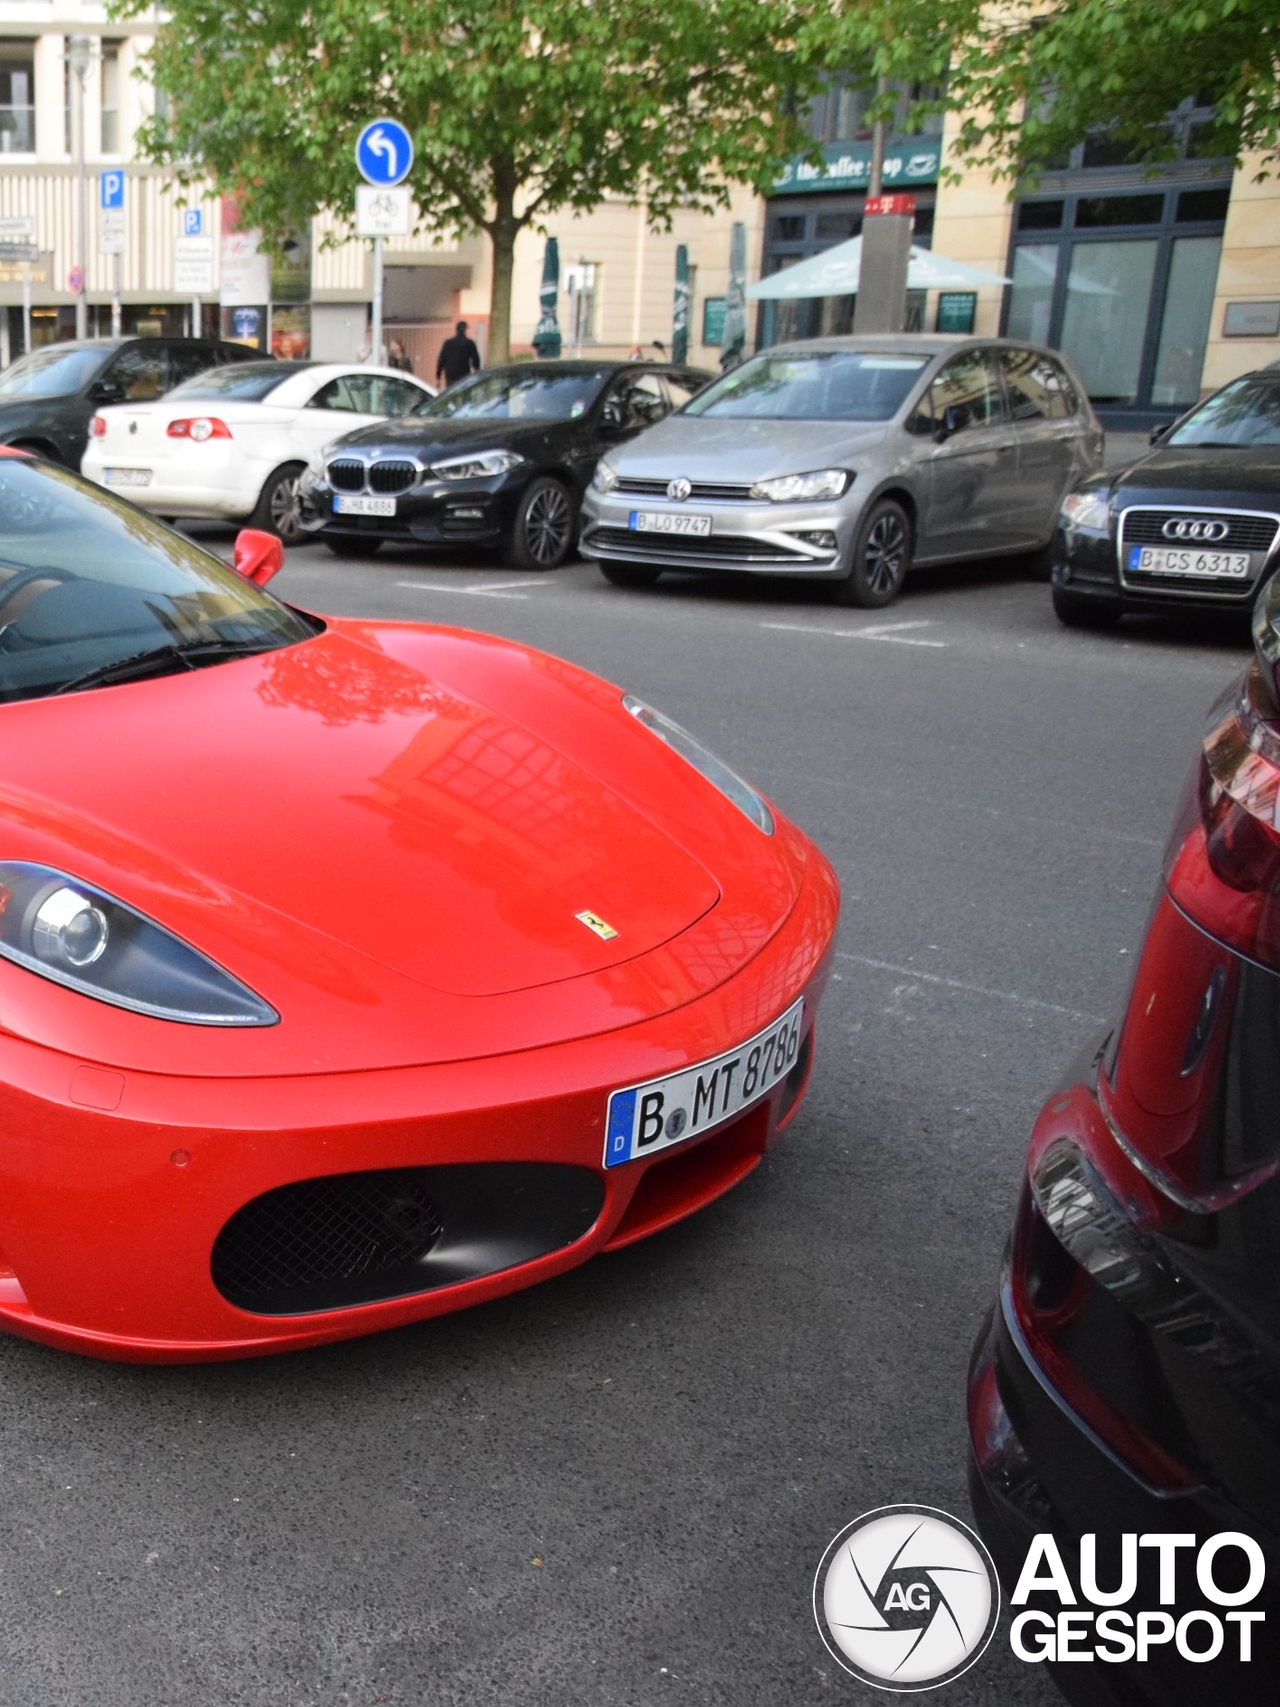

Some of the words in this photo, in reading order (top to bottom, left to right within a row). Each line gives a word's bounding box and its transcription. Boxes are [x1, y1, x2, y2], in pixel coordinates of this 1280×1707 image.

[105, 174, 120, 206] P
[639, 515, 646, 529] B
[675, 517, 708, 534] 9747
[1141, 550, 1153, 567] B
[1165, 552, 1190, 570] CS
[1196, 554, 1246, 574] 6313
[614, 1136, 624, 1152] D
[637, 1091, 665, 1148] B
[692, 1058, 740, 1127] MT
[742, 1014, 799, 1098] 8786
